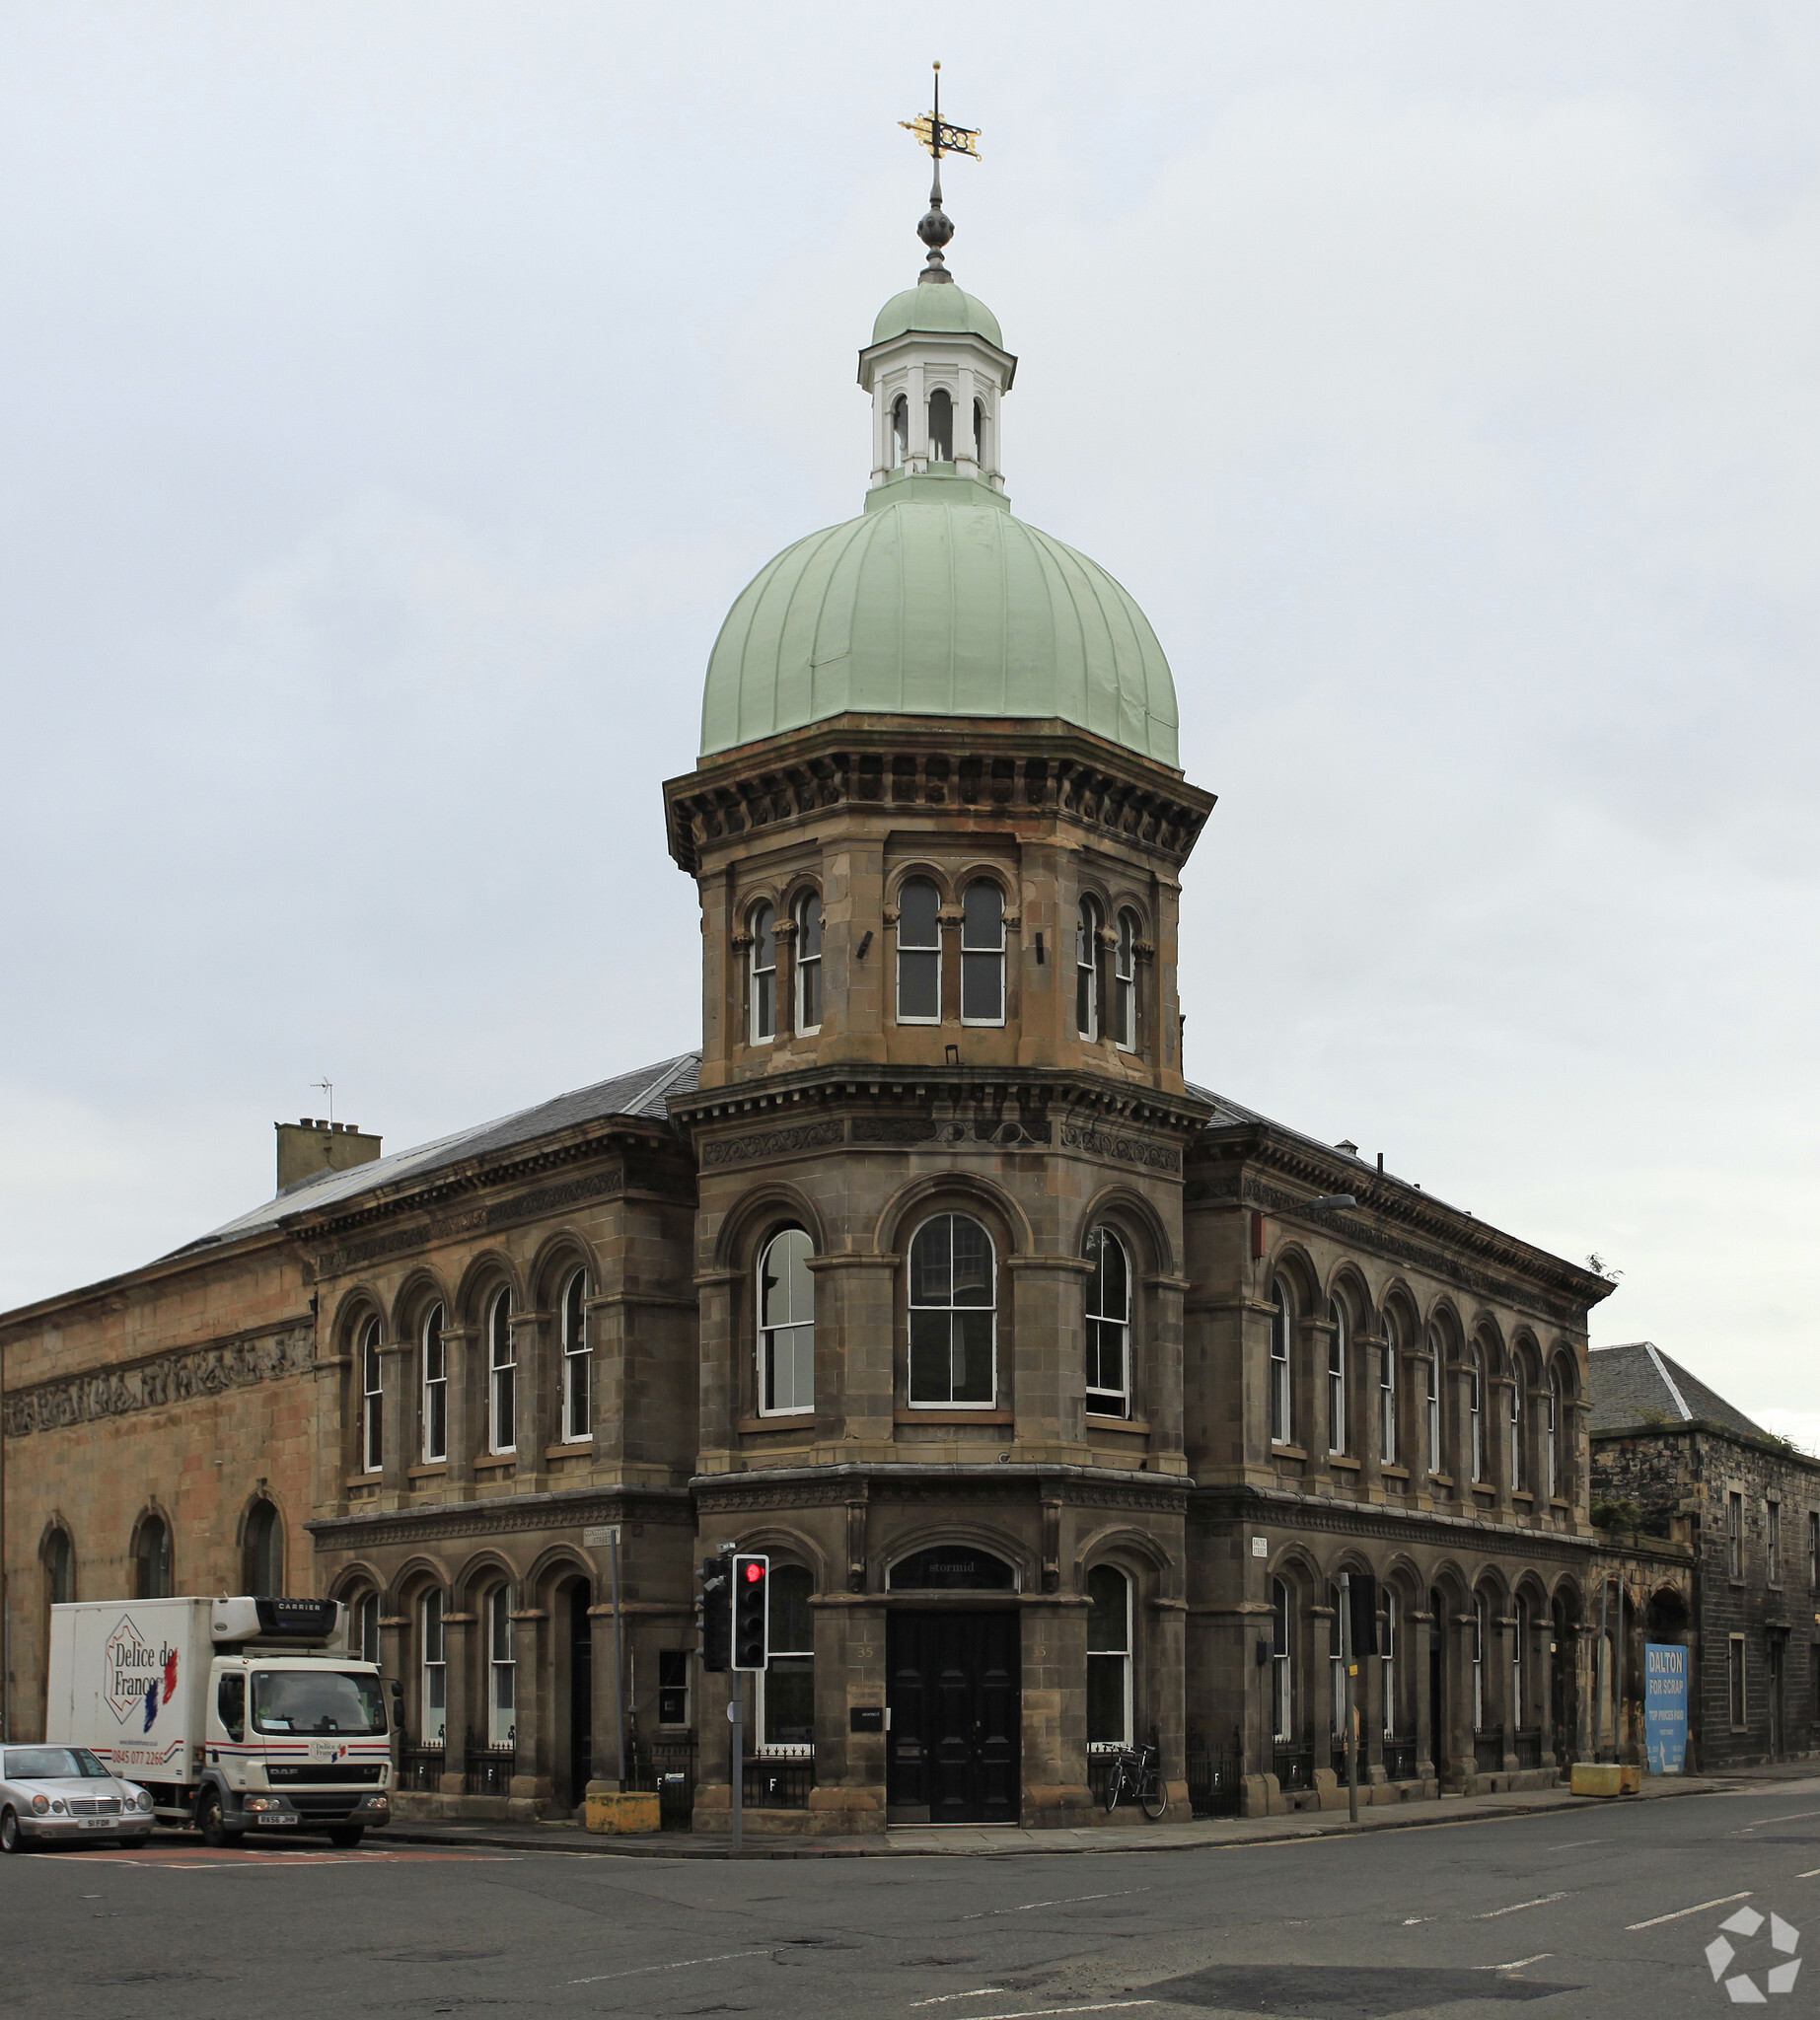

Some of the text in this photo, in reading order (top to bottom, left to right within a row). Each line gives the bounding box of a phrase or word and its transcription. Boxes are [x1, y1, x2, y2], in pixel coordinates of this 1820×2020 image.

[1253, 1547, 1267, 1555] STREET
[929, 1561, 975, 1572] stormid
[115, 1640, 176, 1667] Delice de
[858, 1646, 873, 1658] 35
[1649, 1651, 1683, 1674] DALTON
[1649, 1679, 1684, 1695] FOR SCRAP
[1648, 1709, 1685, 1721] TOP PRICES PAID
[111, 1749, 165, 1767] 0845 077 2266
[769, 1778, 777, 1792] F
